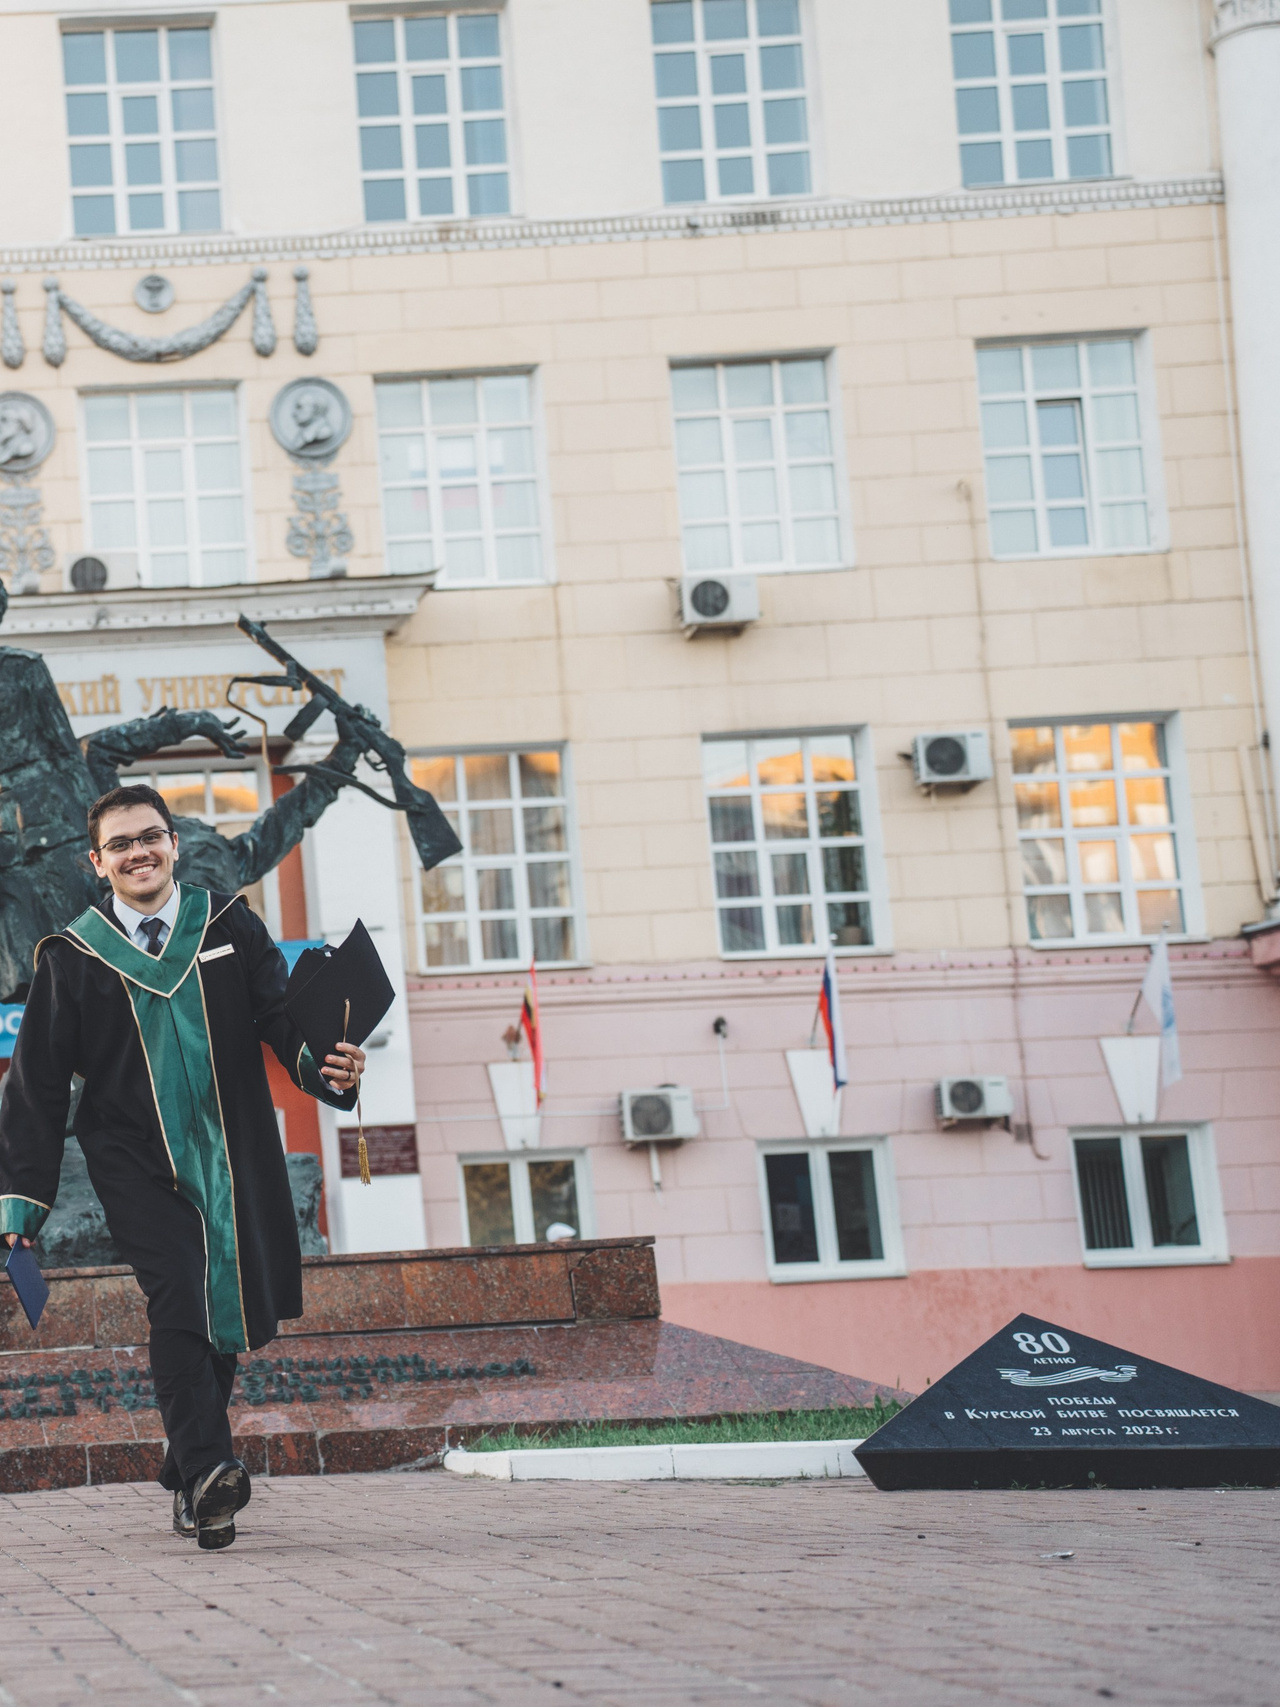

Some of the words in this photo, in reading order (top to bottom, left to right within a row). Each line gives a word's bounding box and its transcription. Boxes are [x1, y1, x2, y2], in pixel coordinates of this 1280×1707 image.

[136, 668, 345, 713] УНИВЕРСИТ
[1012, 1331, 1071, 1355] 80
[1033, 1356, 1077, 1365] ЛЕТИЮ
[1047, 1396, 1117, 1406] ПОБЕДЫ
[964, 1408, 1047, 1420] КУРСКОЙ
[1056, 1409, 1109, 1419] БИТВЕ
[1030, 1426, 1053, 1437] 23
[1061, 1427, 1117, 1436] АВГУСТА
[1121, 1425, 1164, 1436] 2023
